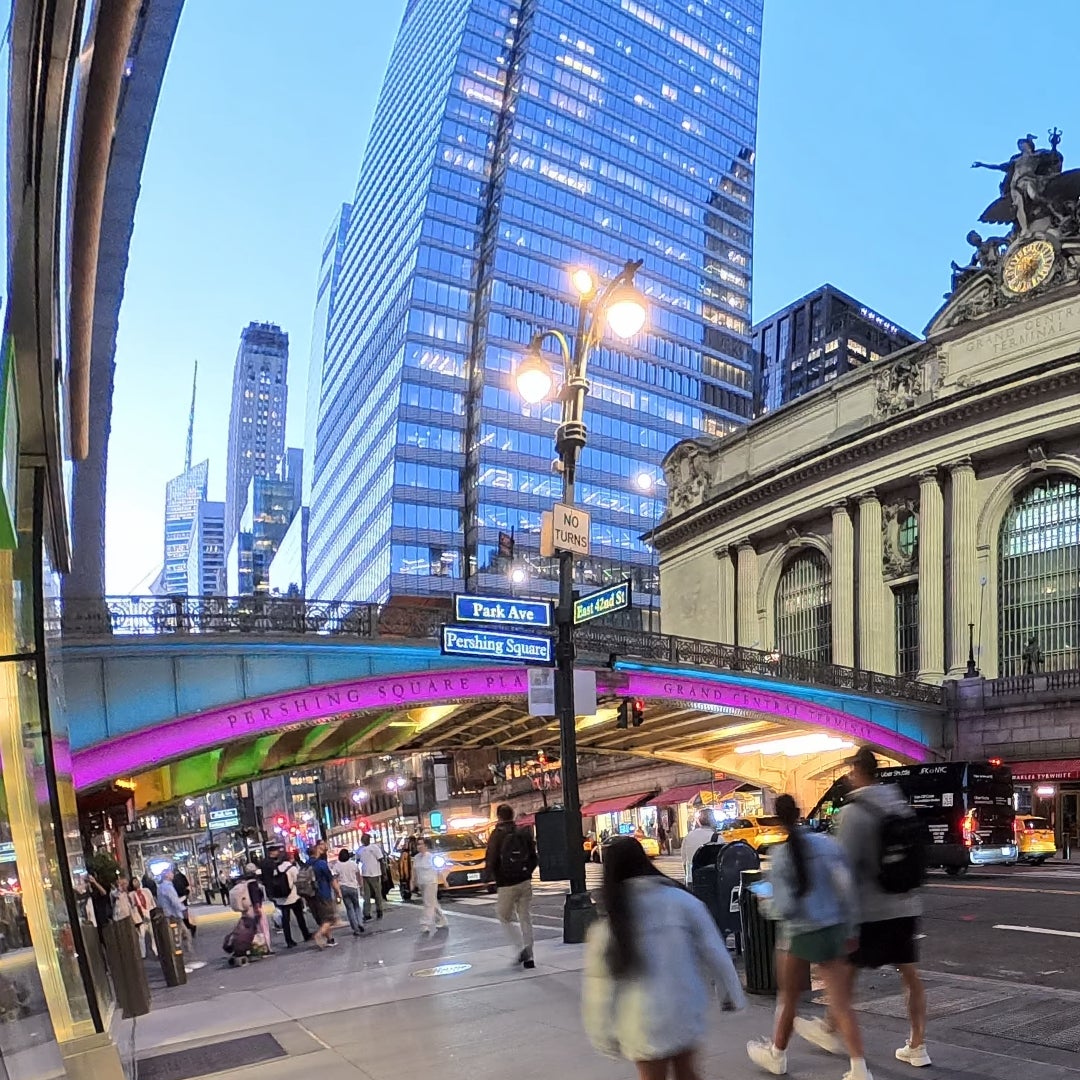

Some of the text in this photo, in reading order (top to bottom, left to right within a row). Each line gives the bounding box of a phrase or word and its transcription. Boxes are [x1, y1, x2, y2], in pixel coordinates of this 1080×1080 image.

[966, 328, 1015, 351] GRAND
[994, 322, 1064, 353] TERMINAL
[563, 512, 579, 527] NO
[555, 528, 587, 548] TURNS
[473, 603, 534, 621] Park Ave
[576, 590, 625, 618] East 42nd St
[447, 632, 547, 658] Pershing Square
[227, 689, 360, 728] PERSHING
[378, 677, 469, 700] SQUARE
[664, 683, 722, 700] GRAND
[733, 693, 800, 715] CENTRAL
